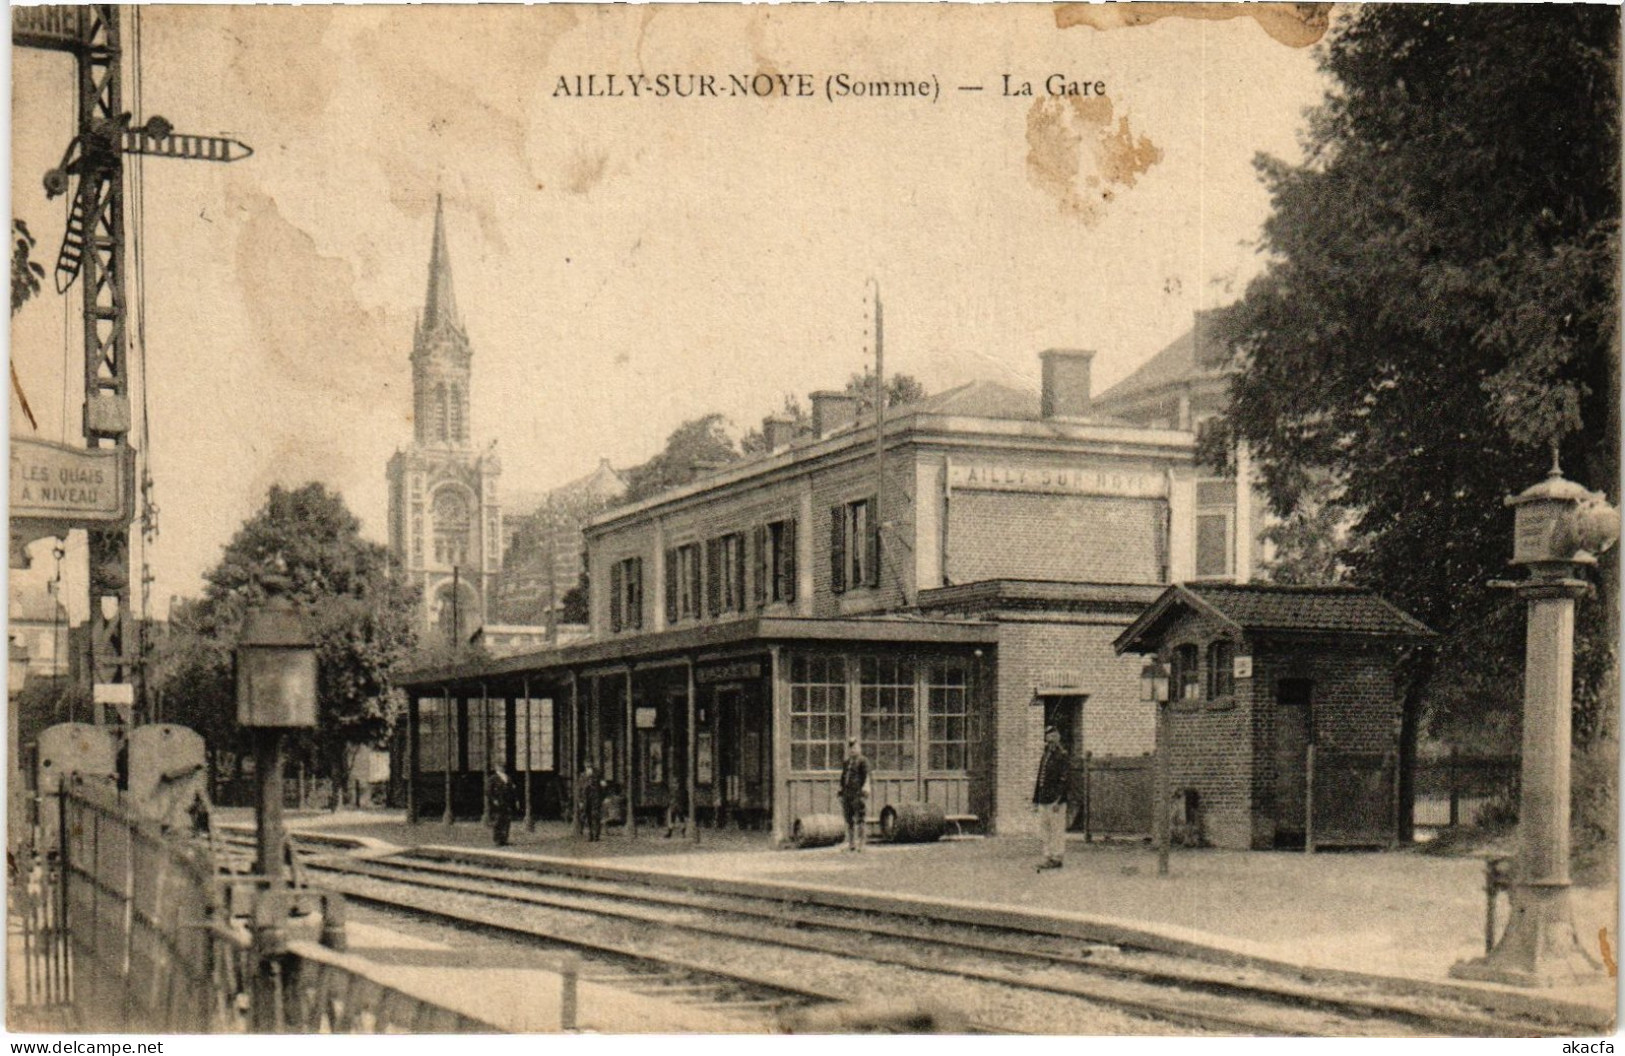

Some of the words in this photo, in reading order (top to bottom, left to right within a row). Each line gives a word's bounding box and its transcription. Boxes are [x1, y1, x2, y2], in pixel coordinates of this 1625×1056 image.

[22, 465, 49, 482] LES
[59, 467, 104, 485] QUAIS
[967, 467, 1027, 484] AILLY
[41, 487, 98, 504] NIVEAU
